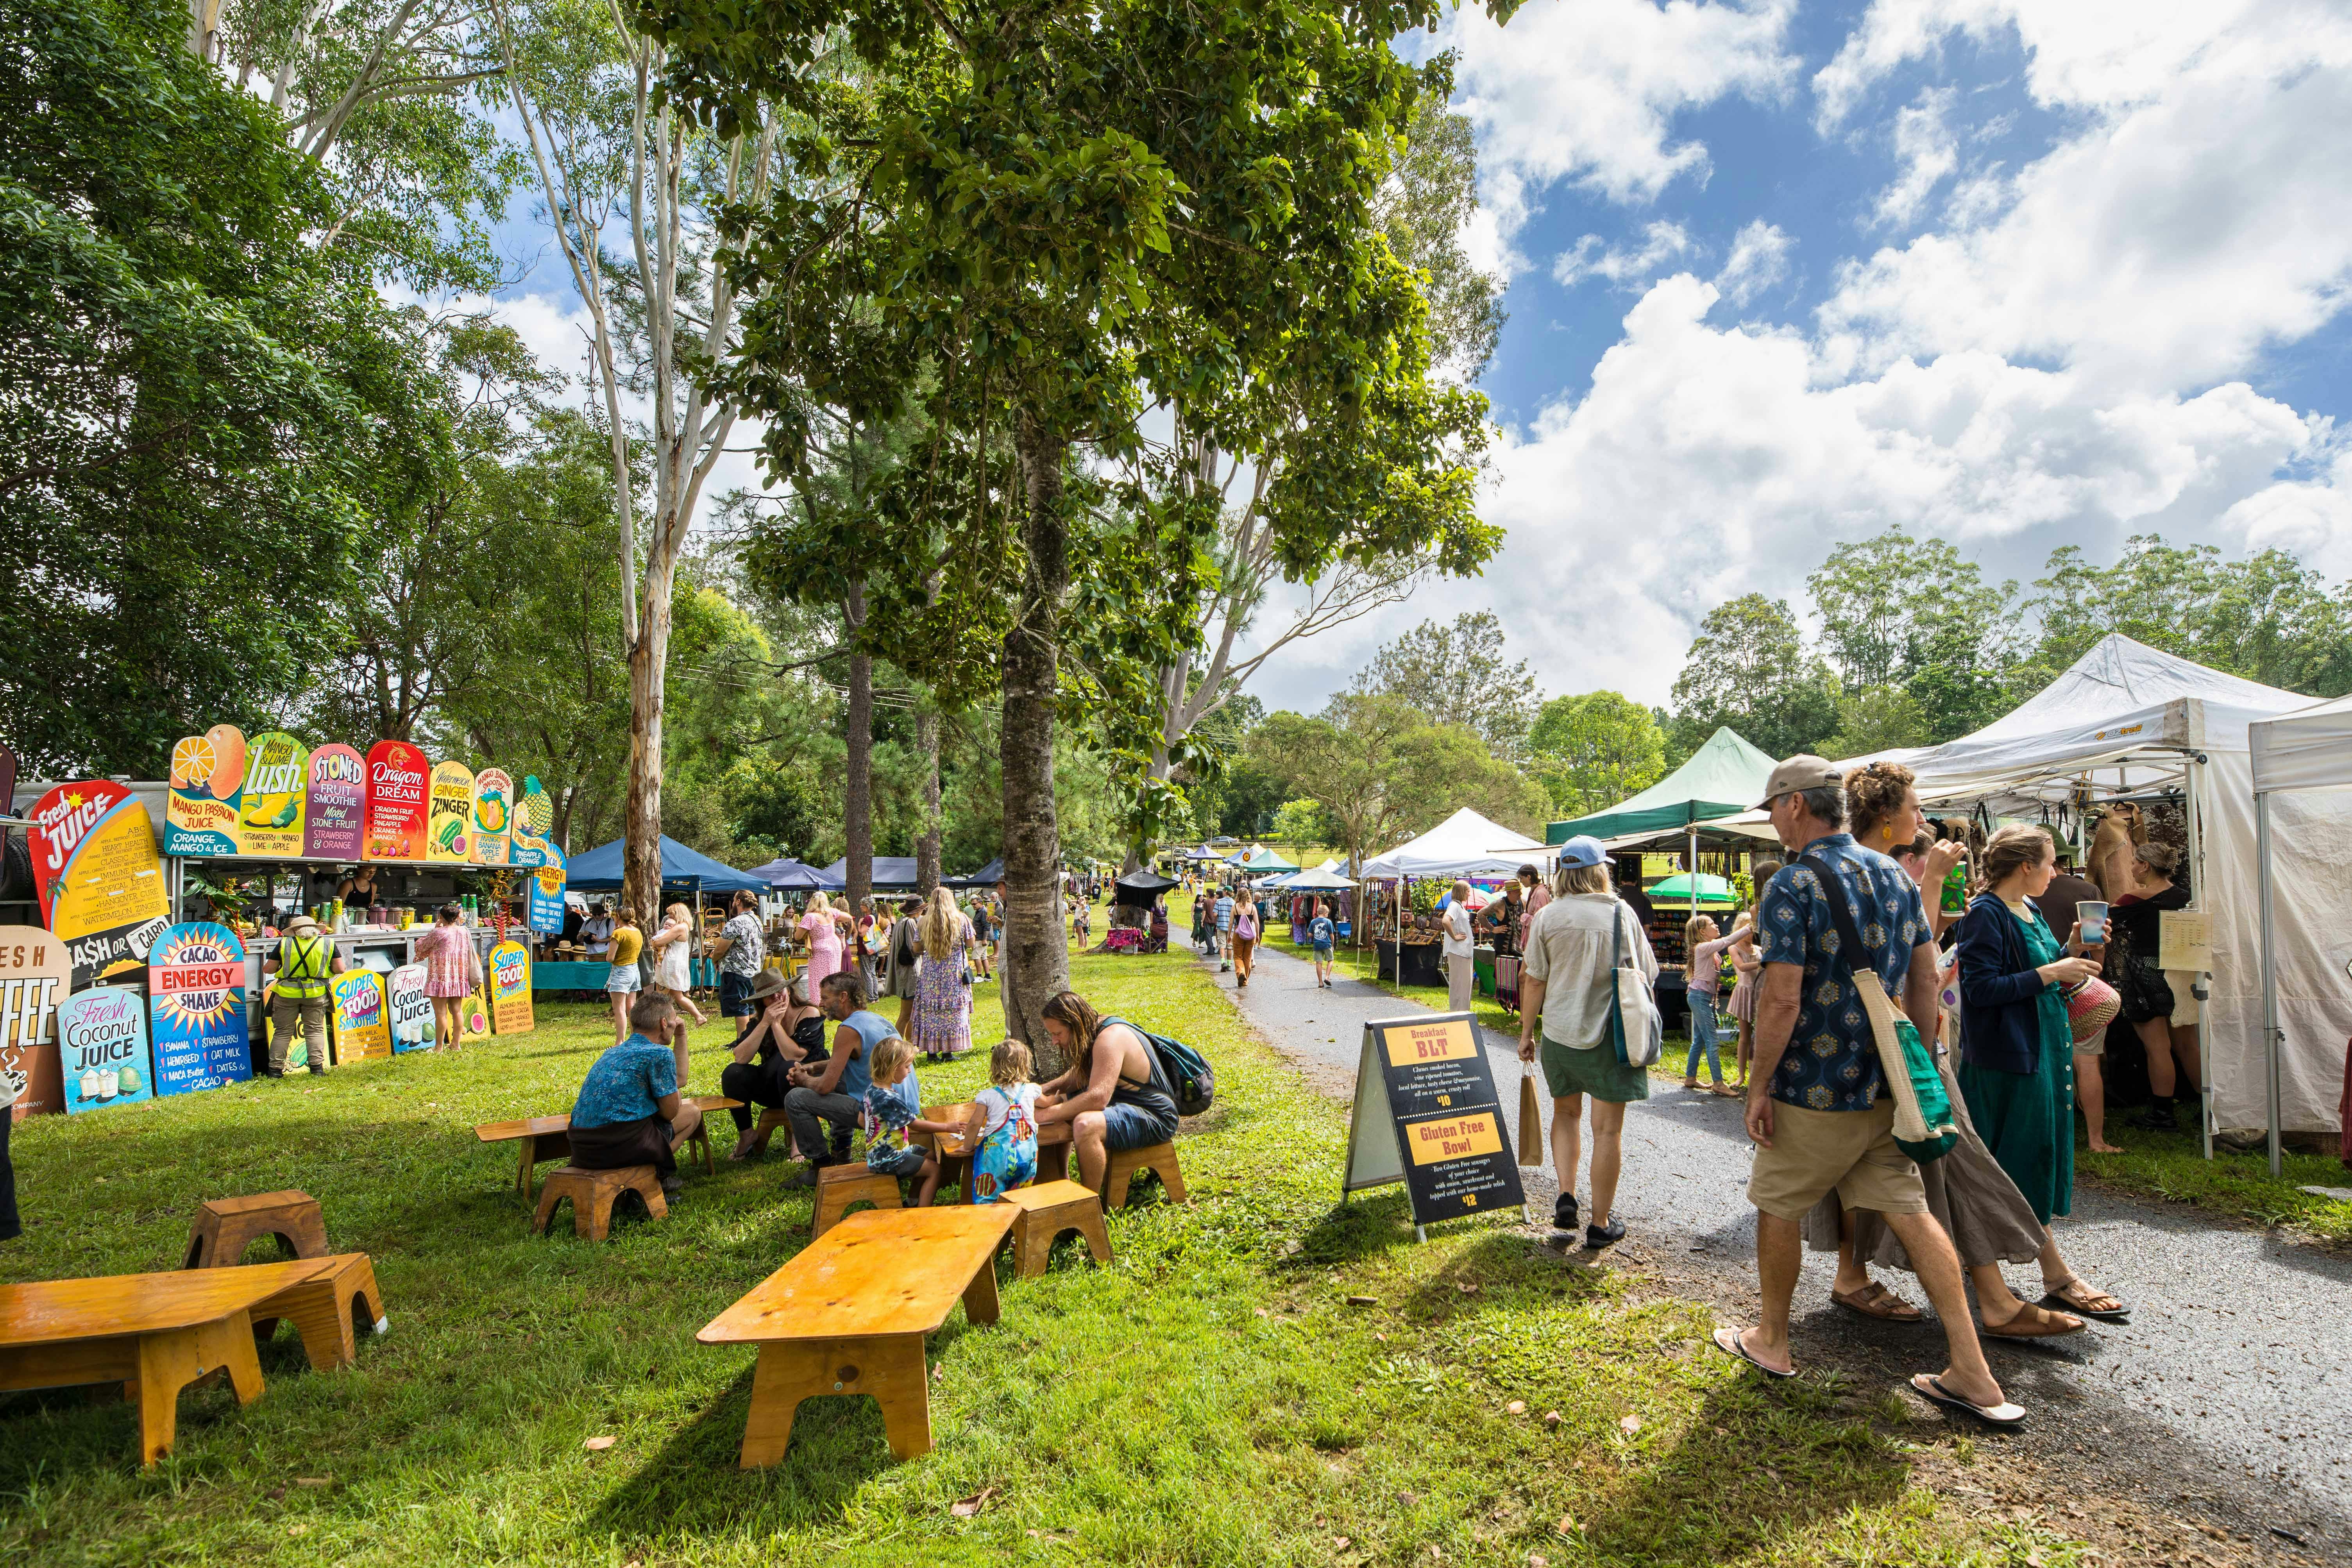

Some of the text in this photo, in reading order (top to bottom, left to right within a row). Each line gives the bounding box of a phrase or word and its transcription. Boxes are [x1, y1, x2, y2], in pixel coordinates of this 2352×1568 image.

[263, 738, 293, 754] MANGO
[268, 755, 290, 765] LIME
[315, 753, 363, 784] STONED
[243, 745, 303, 796] Lush
[372, 762, 424, 788] Dragon
[435, 766, 470, 787] Watermelon
[478, 770, 511, 789] MANGO BANANA
[481, 780, 506, 794] SMOOTHY
[320, 784, 352, 796] FRUIT
[376, 786, 420, 800] DREAM
[434, 784, 469, 799] GINGER
[314, 794, 356, 806] SMOOTHIE
[38, 790, 71, 839] Fresh
[173, 796, 234, 822] MANGO PASSION
[324, 806, 348, 819] Mixed
[374, 813, 409, 821] STRAWBERRY
[375, 805, 398, 814] DRAGON
[431, 797, 469, 822] ZINGER
[47, 792, 113, 870] JUICE
[128, 826, 145, 834] ABC
[185, 817, 213, 828] JUICE
[312, 818, 356, 829] STONE FRUIT
[173, 833, 215, 843] ORANGE
[313, 830, 354, 840] STRAWBERRY
[514, 831, 547, 851] PINE PASSION
[102, 838, 148, 852] HEART HEALTH
[170, 844, 204, 852] MANGO
[213, 844, 227, 853] ICE
[313, 839, 351, 849] & ORANGE
[100, 850, 151, 865] CLASSIC JUICE
[516, 850, 542, 859] PINEAPPLE
[518, 856, 540, 865] ORANGE
[547, 857, 557, 867] ACAO
[100, 863, 153, 880] IMMUNE BOOST
[538, 866, 563, 881] ENERGY
[96, 875, 155, 894] TROPICAL DETOX
[542, 880, 557, 891] SHAKE
[99, 888, 158, 907] HANGOVER CURE
[82, 901, 161, 925] WATERMELON ZINGER
[113, 938, 129, 955] OR
[180, 946, 217, 964] CACAO
[494, 948, 526, 974] SUPER
[161, 968, 234, 989] ENERGY
[392, 968, 425, 994] Fresh
[497, 966, 524, 986] FOOD
[335, 973, 379, 1008] SUPER
[495, 979, 527, 1000] SMOOTHIE
[181, 992, 219, 1010] SHAKE
[344, 989, 379, 1019] FOOD
[64, 994, 131, 1031] Fresh
[397, 1001, 430, 1024] JUICE
[67, 1014, 137, 1048] Coconut
[1410, 1027, 1447, 1038] Breakfast
[165, 1034, 238, 1052] BANANA STRAWBERRY
[1416, 1038, 1448, 1058] BLT
[74, 1037, 134, 1071] JUICE
[211, 1049, 224, 1060] OAT
[225, 1047, 241, 1058] MILK
[168, 1070, 186, 1082] MACA
[187, 1067, 205, 1078] Butter
[216, 1062, 237, 1073] DATES
[1426, 1072, 1442, 1080] ripened
[191, 1076, 221, 1089] CACAO
[11, 1100, 44, 1110] OMPANY
[1437, 1095, 1451, 1107] $10
[1420, 1121, 1485, 1141] Gluten Free
[1442, 1138, 1472, 1155] Bowl
[1454, 1171, 1465, 1180] your
[1430, 1191, 1445, 1201] topped
[1467, 1182, 1492, 1192] home-made
[1493, 1179, 1505, 1188] relish
[1462, 1194, 1477, 1207] $12
